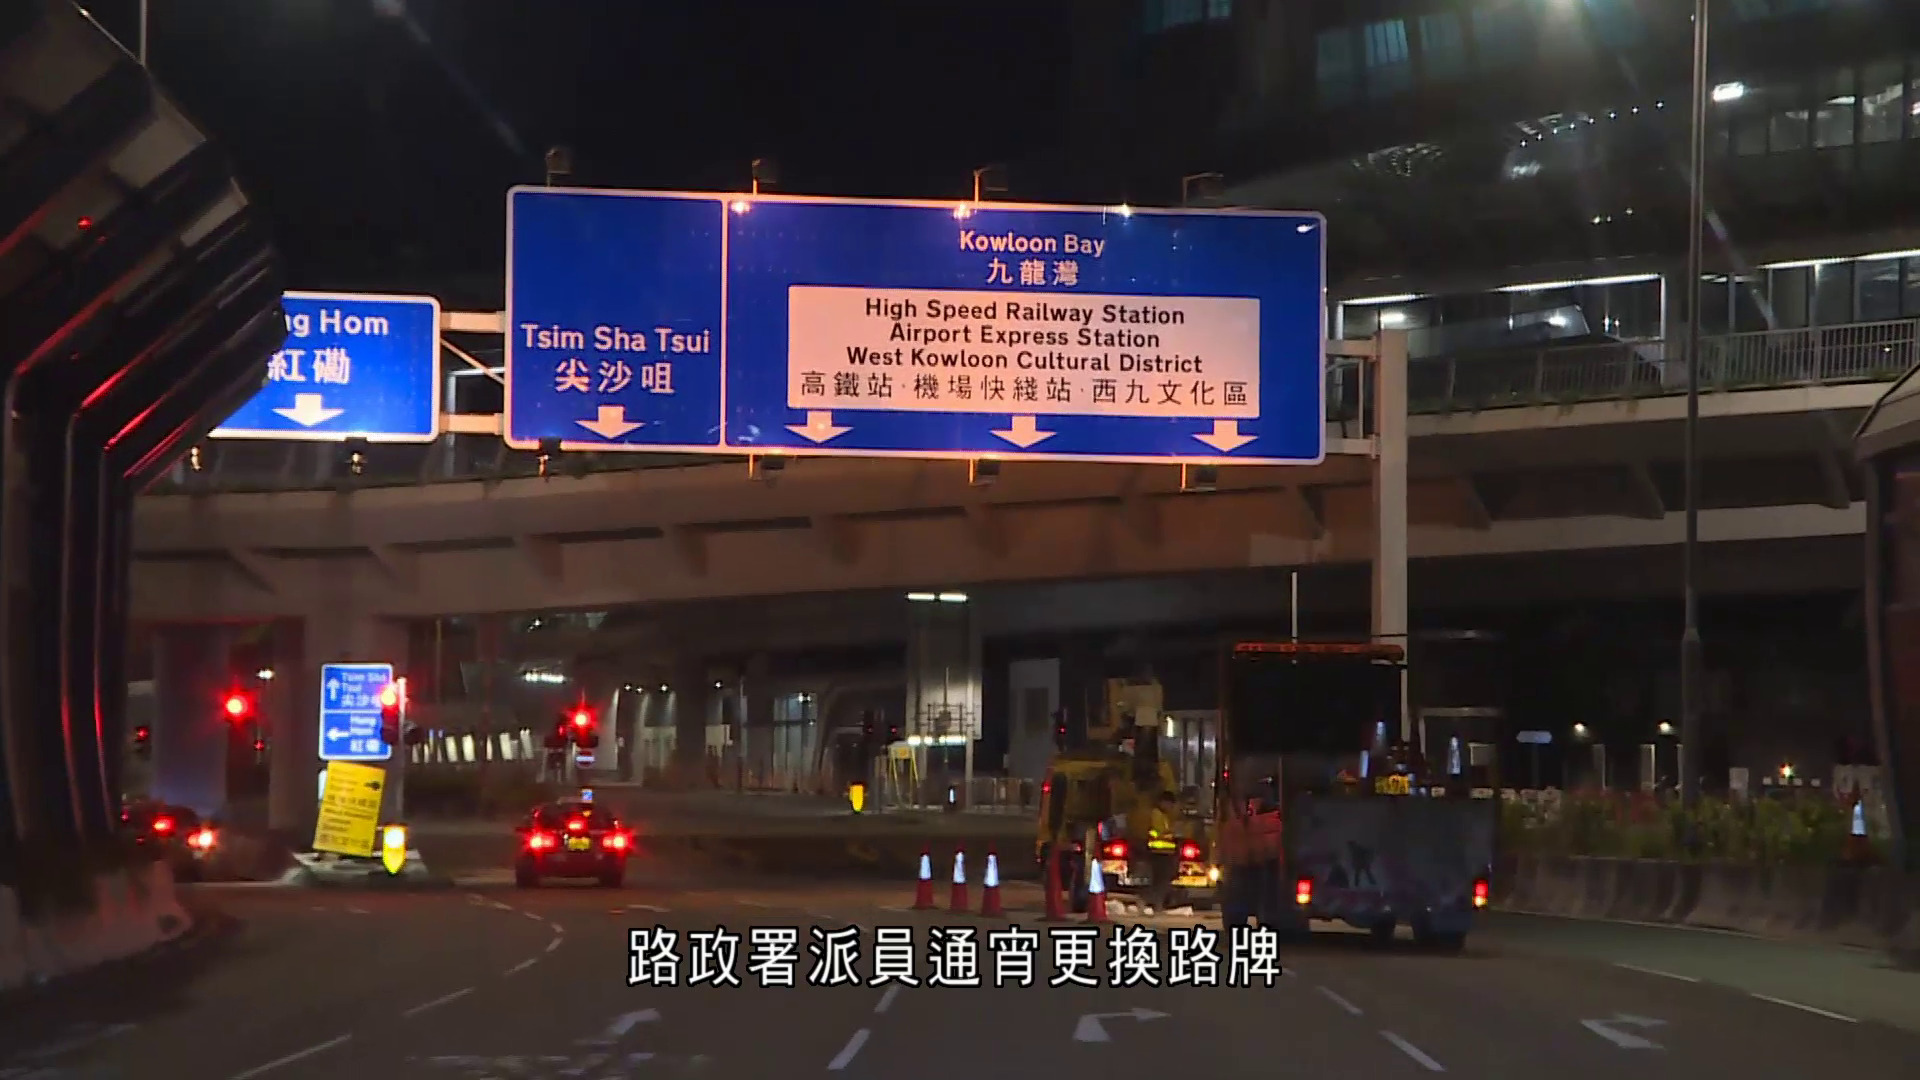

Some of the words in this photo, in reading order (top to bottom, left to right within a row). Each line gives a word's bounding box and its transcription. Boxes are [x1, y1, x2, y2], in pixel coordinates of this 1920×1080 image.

[960, 230, 1057, 253] Kowloon
[1064, 234, 1105, 258] Bay
[986, 257, 1079, 286] 九龍灣
[320, 308, 389, 336] Hom
[865, 298, 917, 321] High
[926, 299, 997, 321] Speed
[1006, 302, 1093, 325] Railway
[1102, 304, 1185, 325] Station
[520, 323, 585, 350] Tsim
[594, 325, 647, 351] Sha
[654, 328, 711, 353] Tsui
[889, 322, 972, 346] Airport
[981, 325, 1069, 347] Express
[1077, 328, 1160, 348] Station
[847, 346, 904, 366] West
[911, 348, 1008, 369] Kowloon
[1016, 351, 1110, 371] Cultural
[1119, 354, 1203, 374] District
[555, 358, 676, 394] 尖沙咀
